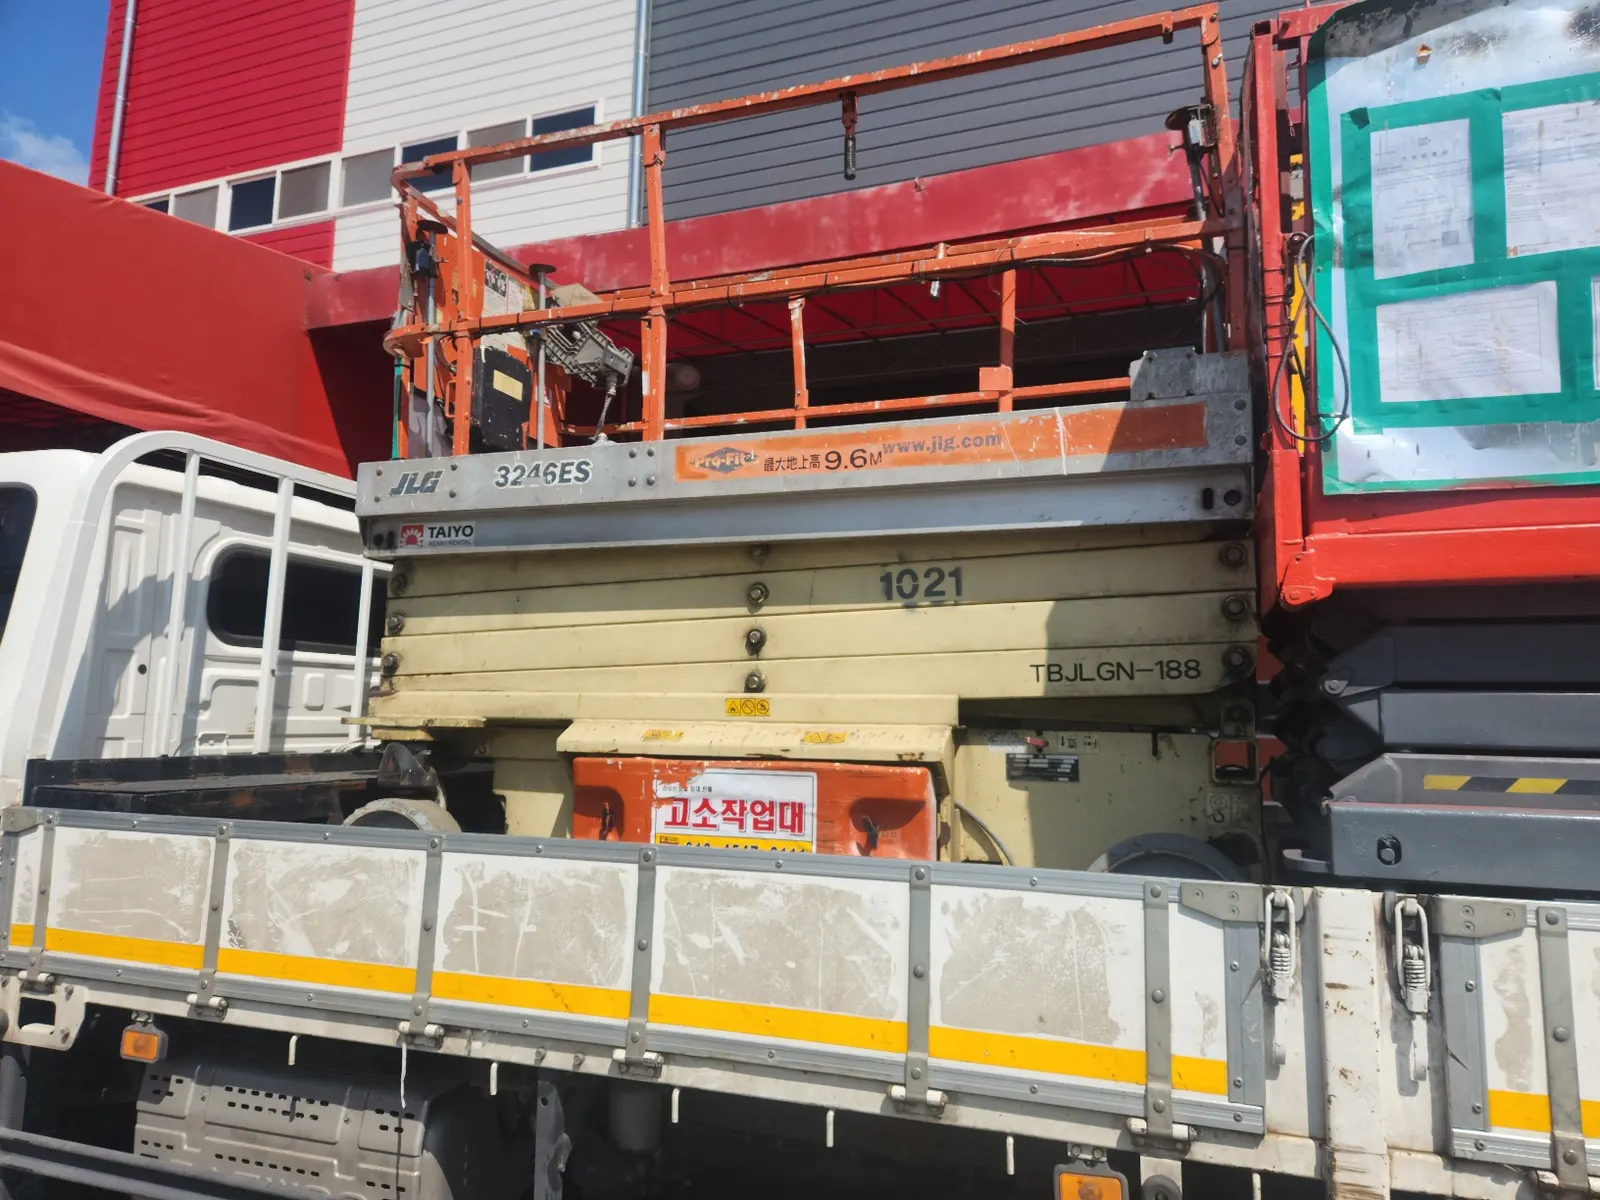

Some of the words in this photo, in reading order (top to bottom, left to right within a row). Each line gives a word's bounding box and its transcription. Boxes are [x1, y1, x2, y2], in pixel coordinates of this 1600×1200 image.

[494, 460, 592, 488] 3246ES
[763, 453, 821, 473] 最大地上高
[389, 470, 443, 496] JLG
[428, 525, 474, 538] TAIYO
[879, 566, 963, 601] 1021
[1029, 659, 1201, 683] TBJLGN-188
[663, 797, 806, 835] 고소작업대
